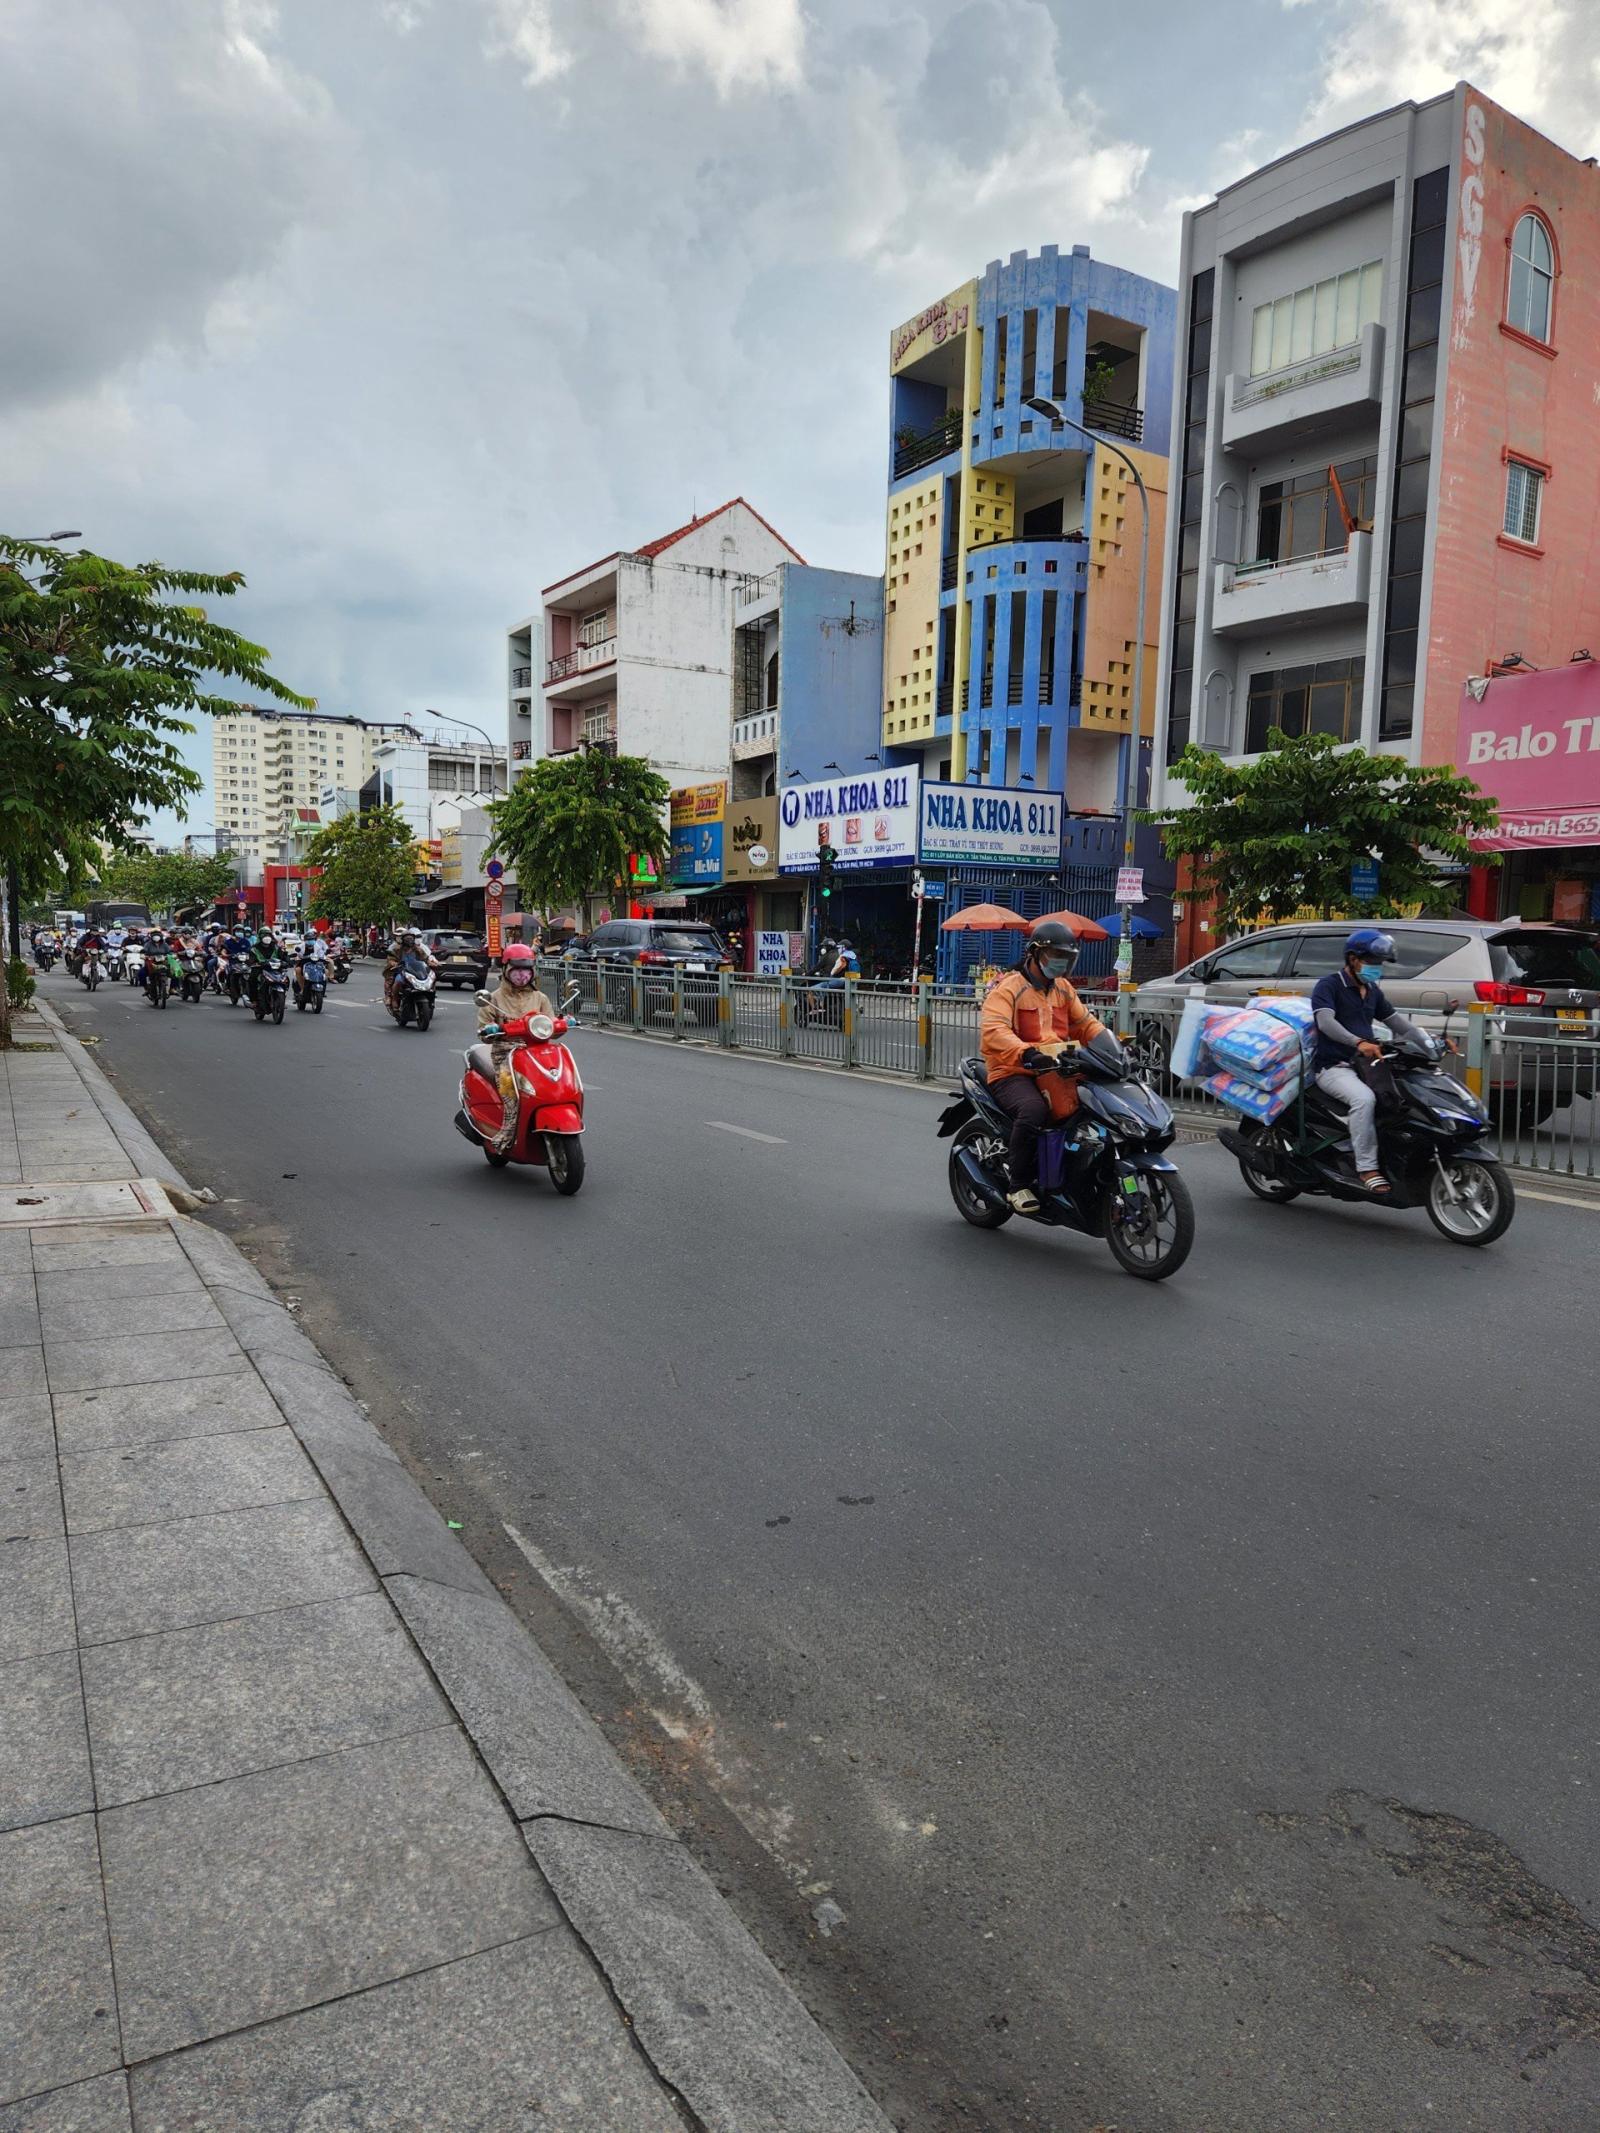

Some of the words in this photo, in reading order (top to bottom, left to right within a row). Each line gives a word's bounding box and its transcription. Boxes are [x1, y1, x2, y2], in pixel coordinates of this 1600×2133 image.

[1466, 724, 1557, 765] Balo
[804, 788, 834, 819] NHA
[838, 781, 879, 815] KHOA
[883, 776, 909, 808] 811
[927, 793, 967, 830] NHA
[972, 797, 1023, 834] KHOA
[1028, 802, 1056, 835] 811
[1505, 818, 1557, 838] hành
[763, 933, 783, 945] NHA
[759, 949, 787, 961] KHOA
[763, 964, 782, 975] 811
